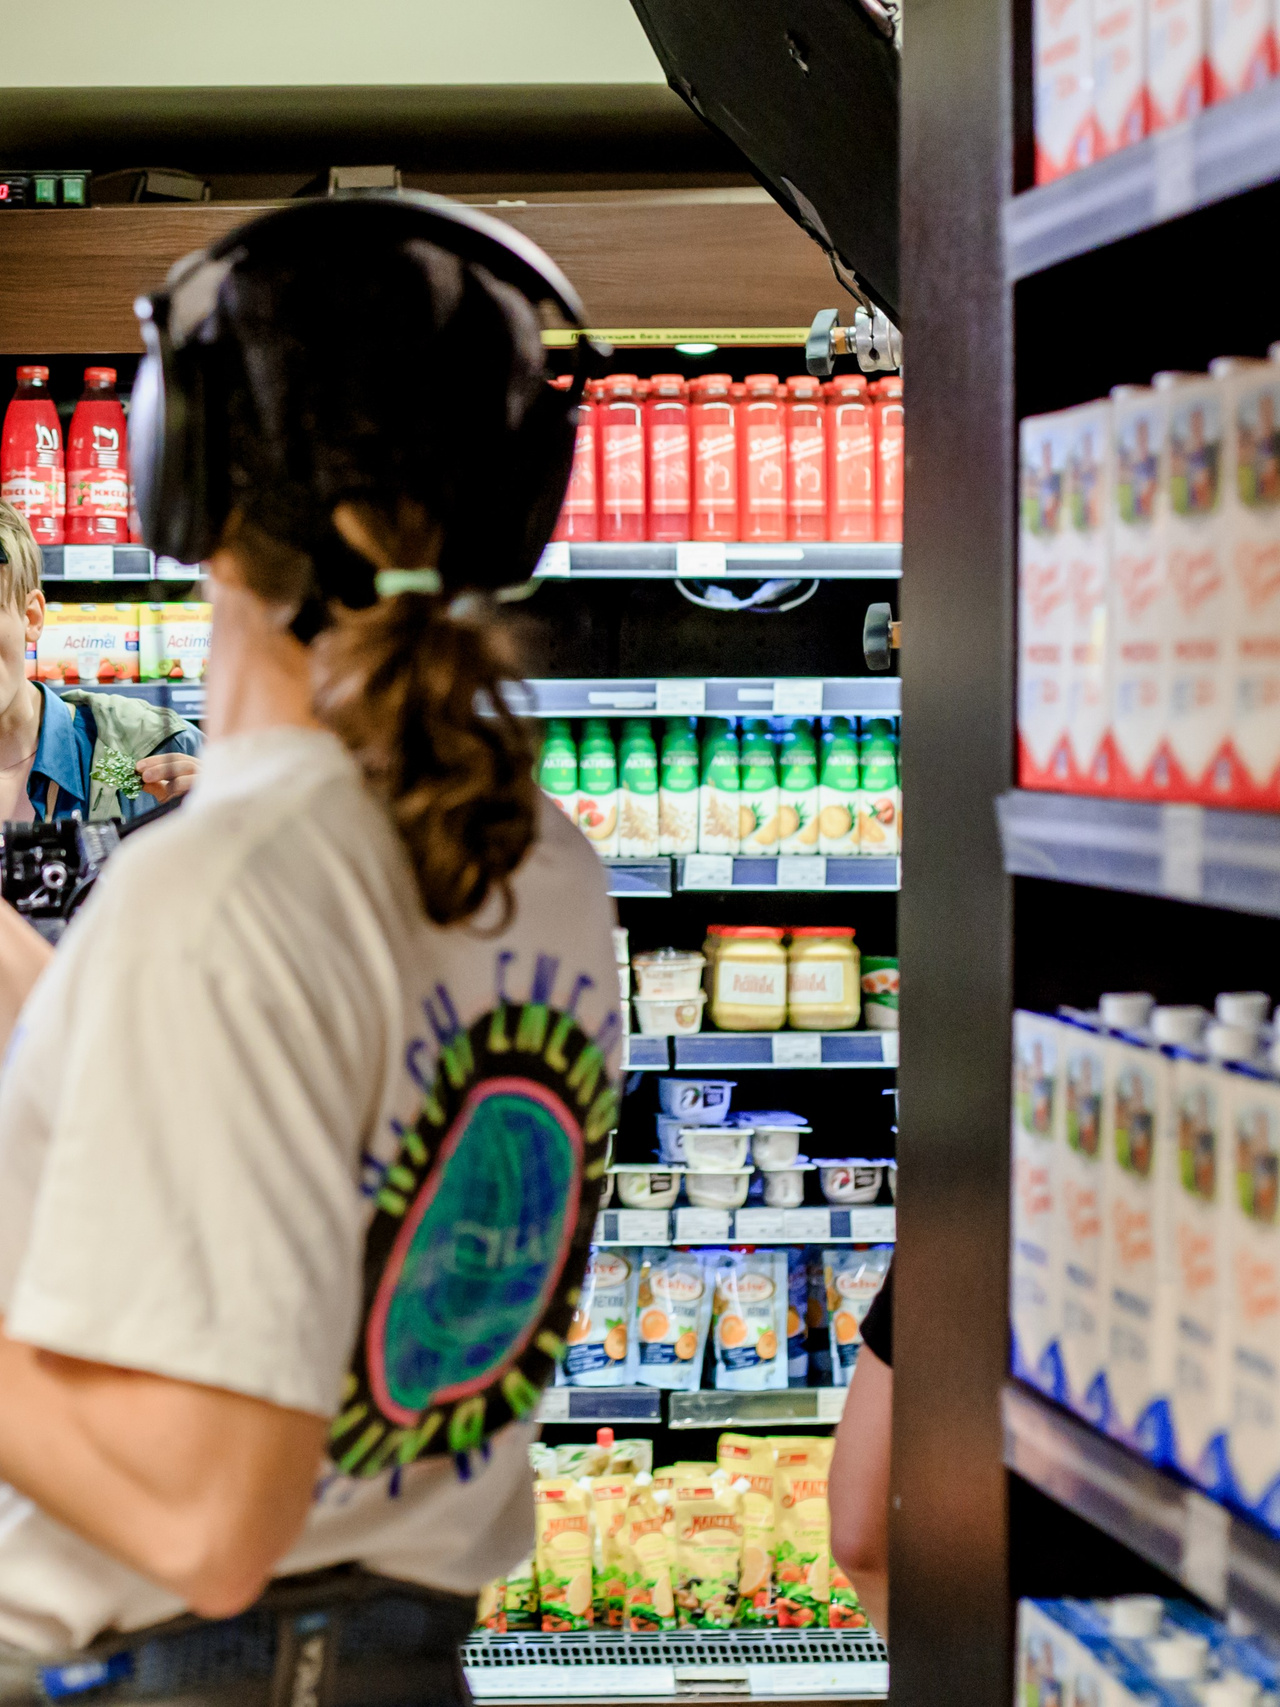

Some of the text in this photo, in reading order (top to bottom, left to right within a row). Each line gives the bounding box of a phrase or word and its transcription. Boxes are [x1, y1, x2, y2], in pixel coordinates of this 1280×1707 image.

[570, 333, 636, 341] Подукция
[94, 489, 128, 497] КИСЕЛ
[64, 632, 116, 648] Actimel
[167, 633, 212, 648] Actime
